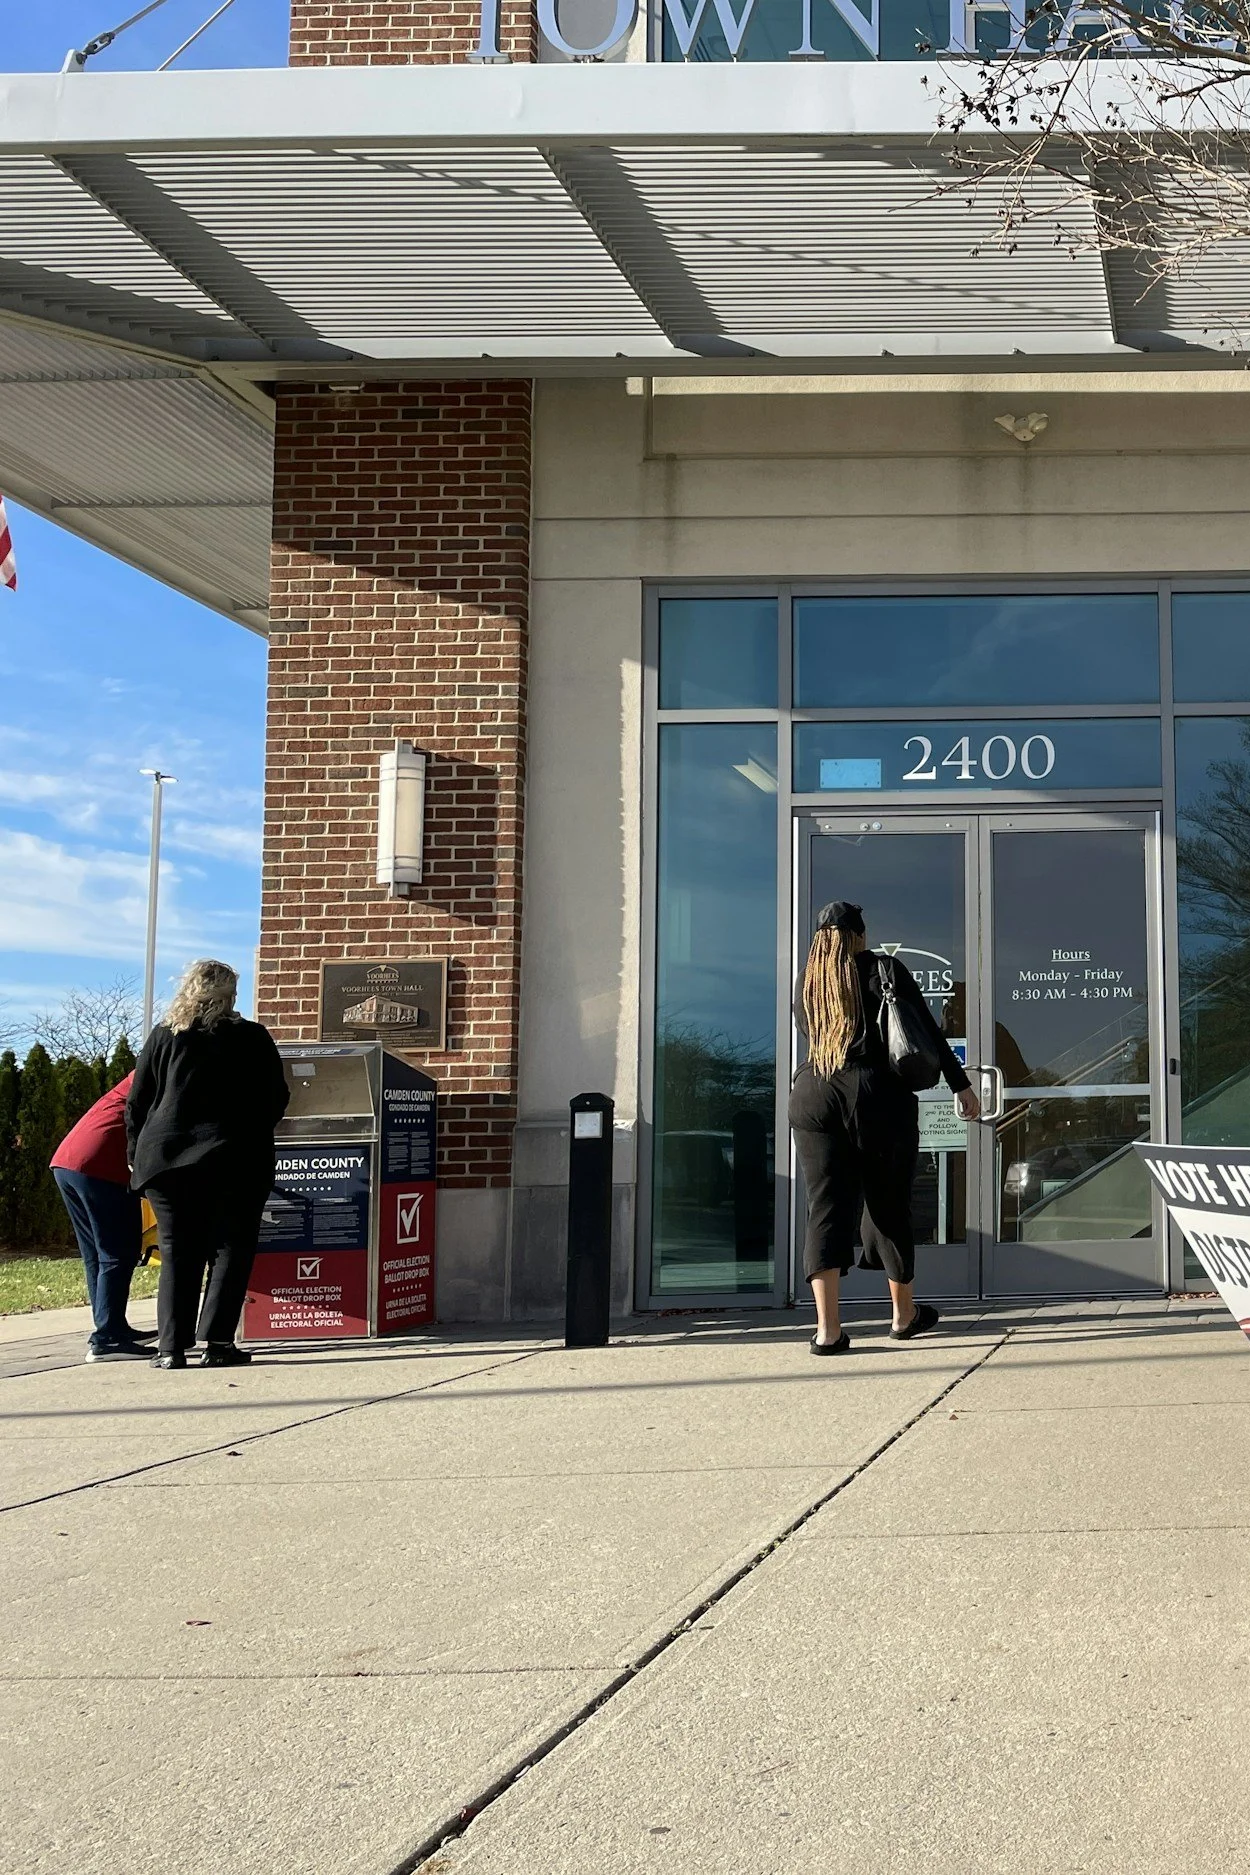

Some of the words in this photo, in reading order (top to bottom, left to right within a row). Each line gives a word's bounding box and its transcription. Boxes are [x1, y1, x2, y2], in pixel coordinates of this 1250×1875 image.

[902, 734, 1055, 780] 2400
[1051, 949, 1091, 961] Hours
[1018, 970, 1070, 983] Monday
[1084, 968, 1123, 982] Friday
[1012, 989, 1040, 1000] 8:30
[1044, 988, 1066, 999] AM
[1080, 987, 1109, 998] 4:30
[1112, 987, 1133, 998] PM
[384, 1089, 410, 1101] CAMDEN
[411, 1089, 435, 1101] COUNTY
[388, 1103, 408, 1111] CONDADO
[408, 1104, 414, 1112] DE
[414, 1104, 431, 1112] CAMDEN
[275, 1159, 308, 1170] MDEN
[311, 1157, 364, 1169] COUNTY
[306, 1172, 316, 1180] DE
[317, 1171, 350, 1179] CAMDEN
[1144, 1158, 1228, 1206] VOTE
[383, 1258, 406, 1271] OFFICIAL
[406, 1254, 430, 1266] ELECTION
[384, 1271, 404, 1284] BALLOT
[404, 1269, 419, 1280] DROP
[419, 1267, 430, 1278] BOX
[305, 1286, 342, 1294] ELECTION
[273, 1295, 302, 1303] BALLOT
[270, 1320, 313, 1328] ELECTORAL
[313, 1319, 343, 1327] OFICIAL
